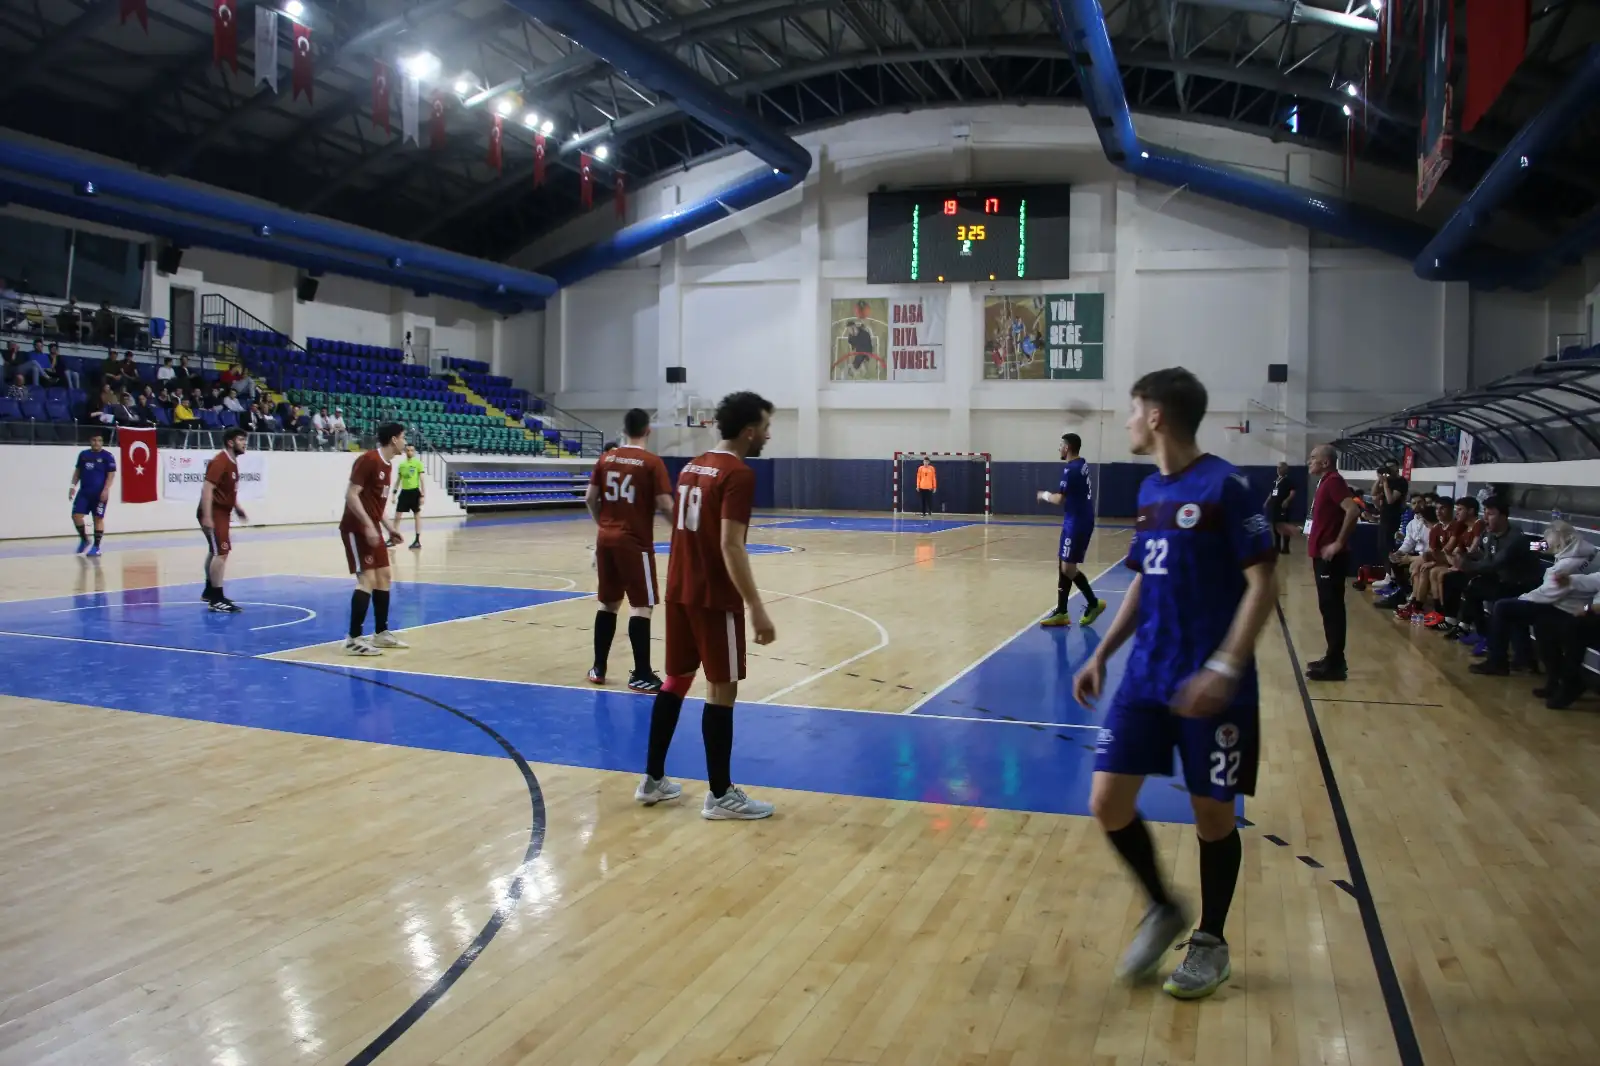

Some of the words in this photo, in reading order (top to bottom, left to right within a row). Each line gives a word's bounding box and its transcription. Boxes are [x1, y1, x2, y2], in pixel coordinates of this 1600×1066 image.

[944, 200, 957, 215] 19
[985, 199, 998, 213] 17
[963, 240, 971, 252] 2
[893, 304, 923, 325] BAŞA
[893, 328, 918, 346] RIYA
[1050, 323, 1083, 345] SEĞE
[892, 349, 937, 370] YÜKSEL
[1050, 348, 1083, 371] ULAŞ
[605, 471, 636, 504] 54
[1143, 538, 1169, 575] 22
[1210, 751, 1241, 786] 22
